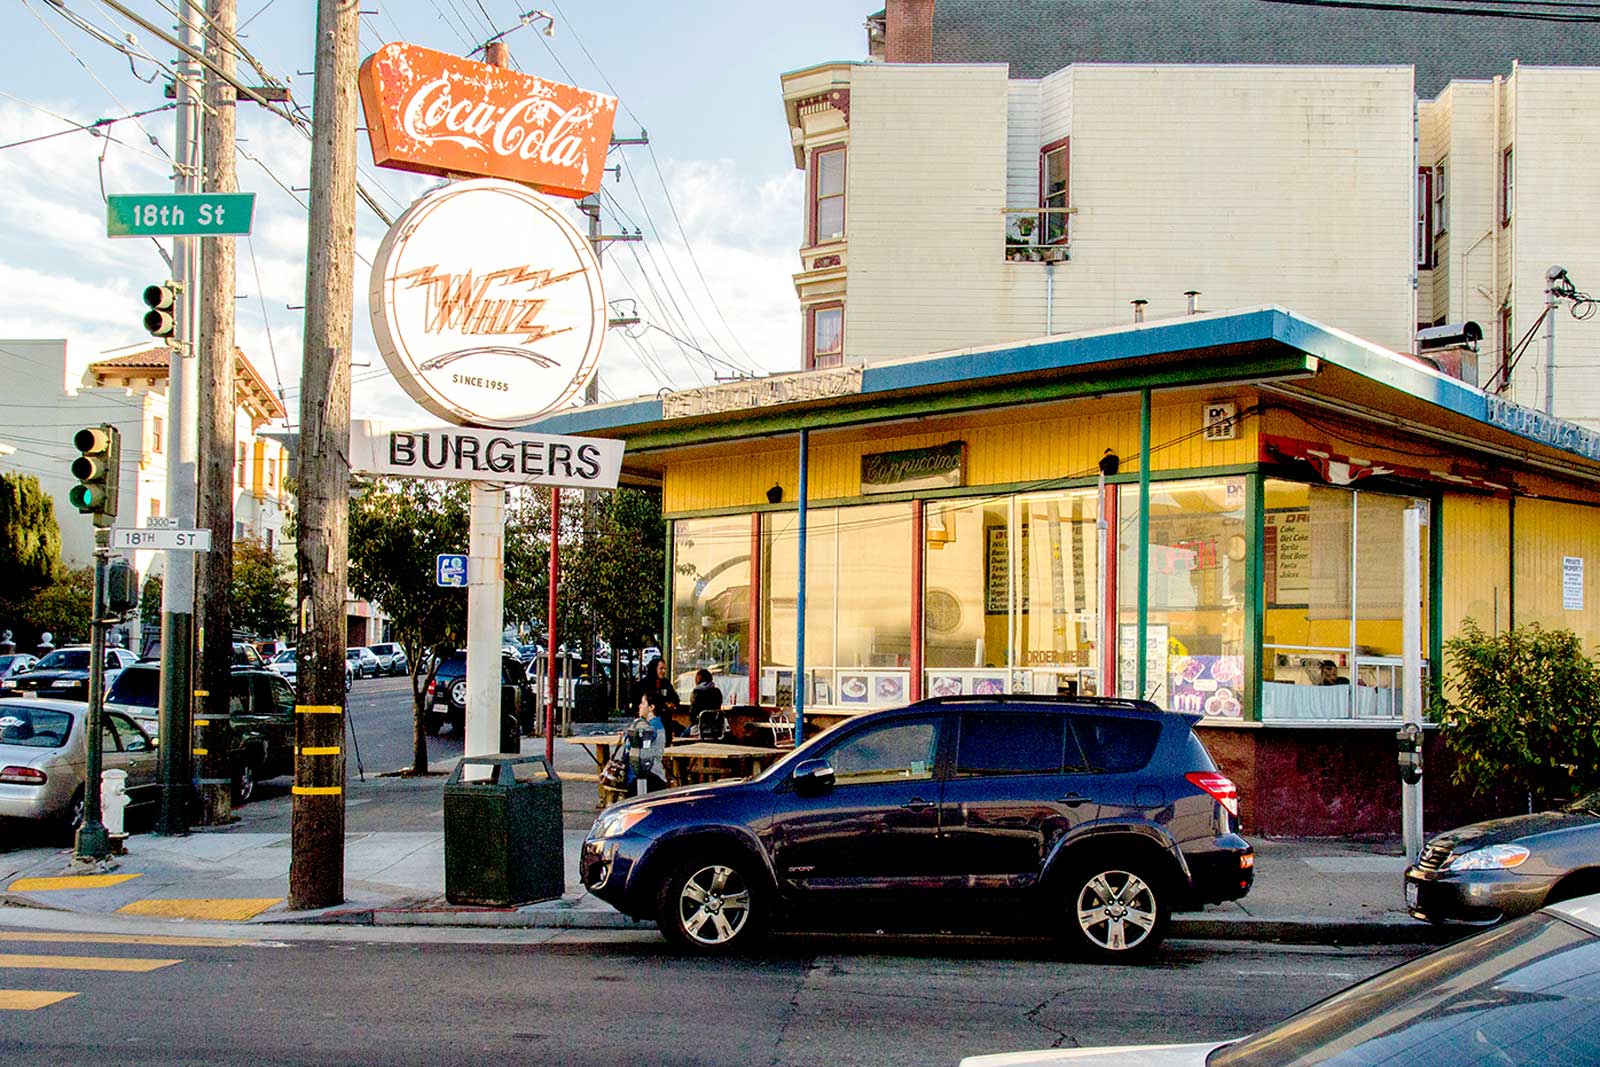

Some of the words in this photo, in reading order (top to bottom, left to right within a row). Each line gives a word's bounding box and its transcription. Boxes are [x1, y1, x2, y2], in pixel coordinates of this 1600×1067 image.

[404, 77, 598, 168] Coca-Cola
[133, 204, 184, 226] 18th
[198, 203, 225, 225] St
[452, 374, 483, 387] SINCE
[485, 379, 509, 391] 1955
[389, 431, 601, 480] BURGERS
[126, 533, 155, 544] 18TH
[176, 533, 196, 546] ST
[1026, 649, 1057, 664] ORDER
